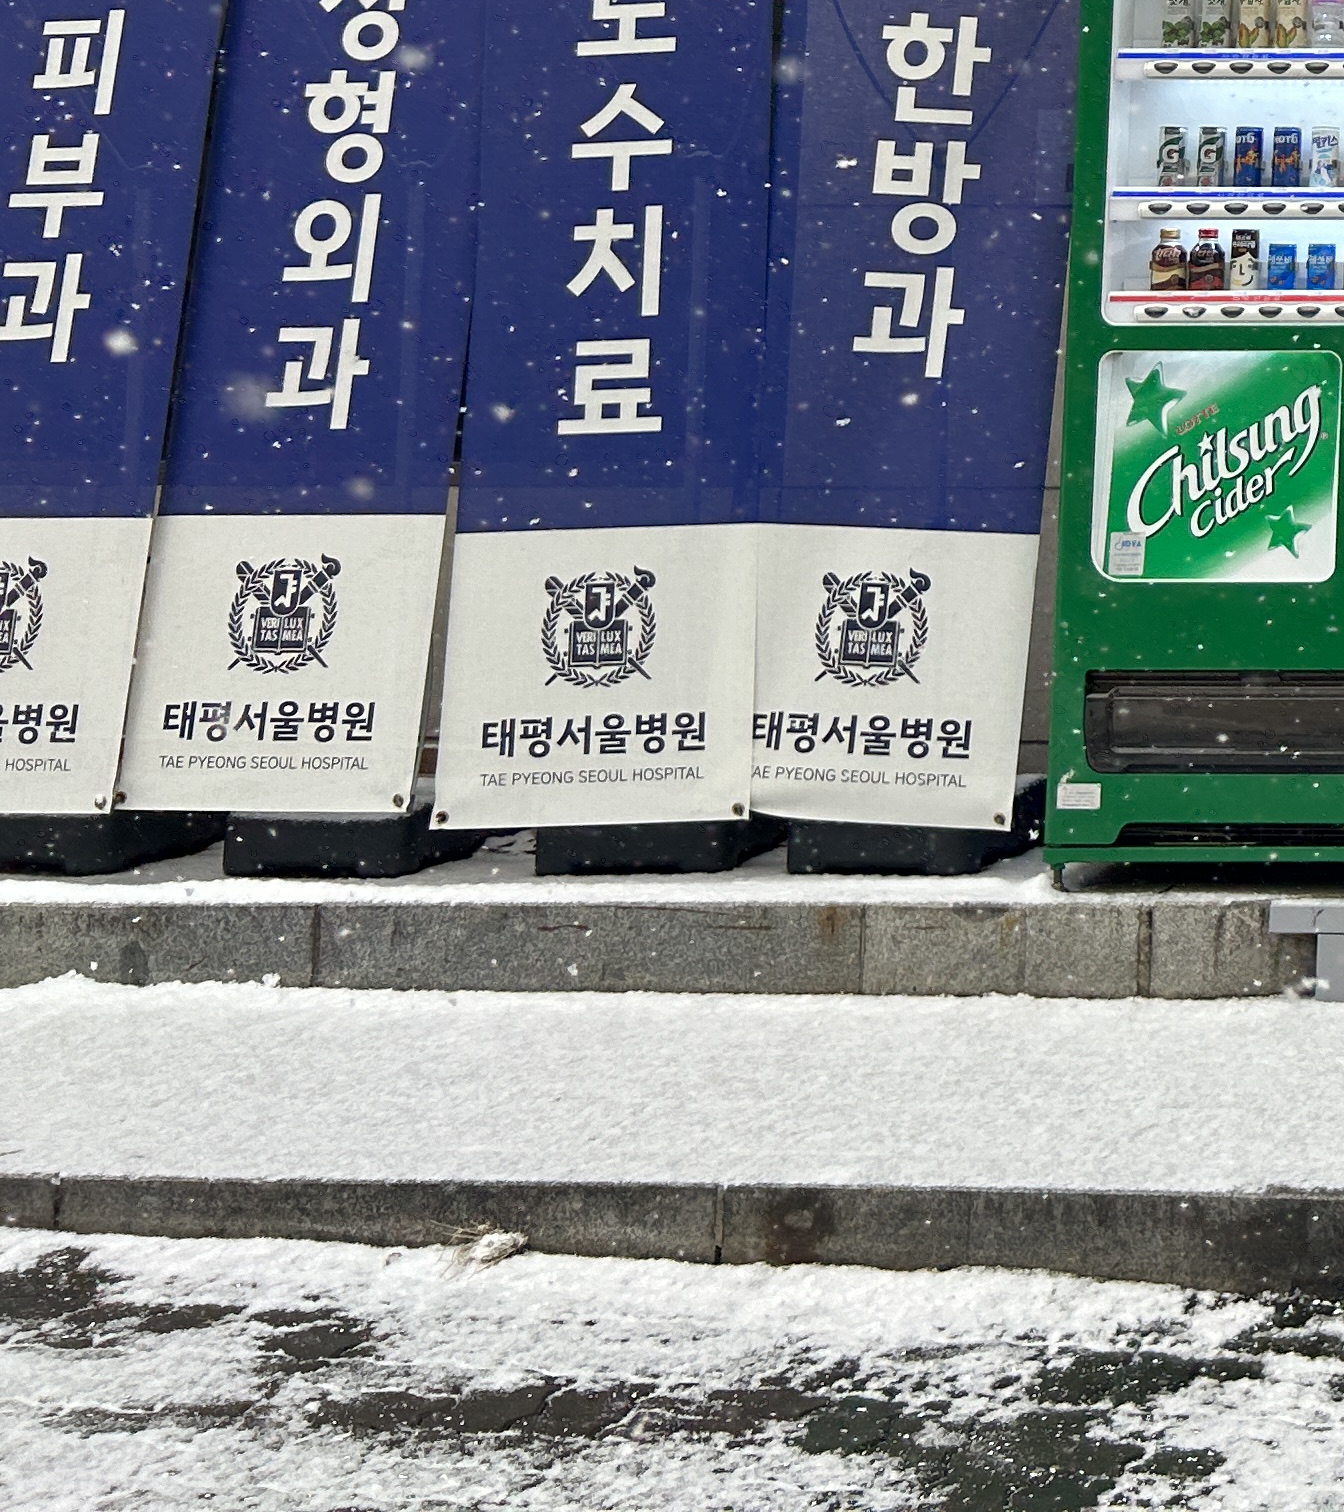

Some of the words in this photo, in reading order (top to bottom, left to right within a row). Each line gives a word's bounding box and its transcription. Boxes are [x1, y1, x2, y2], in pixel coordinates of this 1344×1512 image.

[0, 9, 125, 364] 피부과
[852, 12, 992, 378] 한방과
[1126, 384, 1322, 539] Chilsung
[0, 703, 79, 745] 병원
[162, 700, 376, 743] 태평서울병원
[481, 711, 706, 758] 태평서울병원
[752, 711, 972, 759] 태평서울병원
[5, 757, 72, 772] HOSPITAL
[159, 755, 184, 769] TAE
[188, 755, 246, 769] PYEONG
[250, 756, 298, 770] SEOUL
[301, 756, 369, 770] HOSPITAL
[480, 773, 507, 787] TAE
[511, 770, 575, 786] PYEONG
[578, 769, 628, 784] SEOUL
[632, 766, 705, 782] HOSPITAL
[751, 765, 771, 780] AE
[775, 766, 836, 783] PYEONG
[840, 769, 890, 785] SEOUL
[894, 771, 967, 788] HOSPITAL
